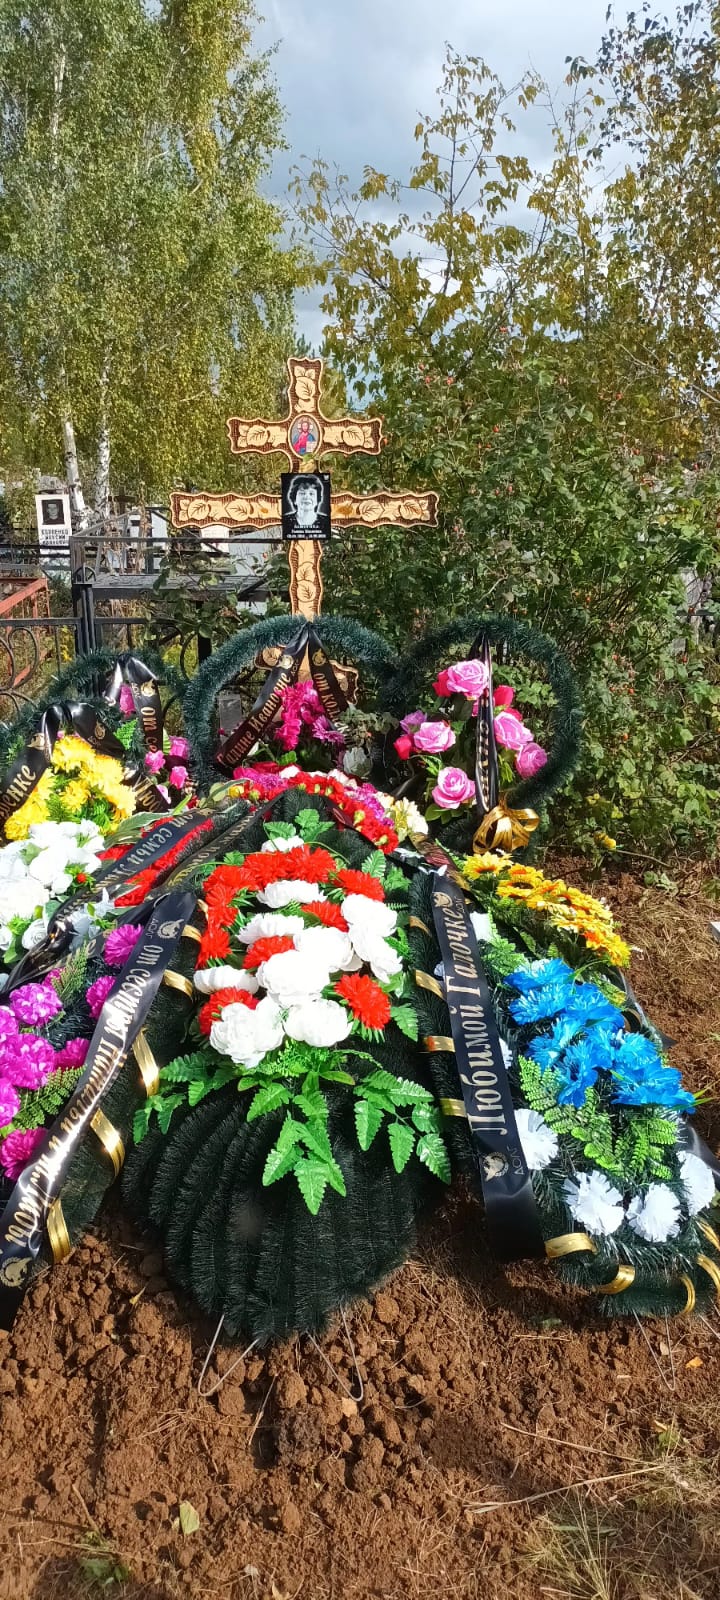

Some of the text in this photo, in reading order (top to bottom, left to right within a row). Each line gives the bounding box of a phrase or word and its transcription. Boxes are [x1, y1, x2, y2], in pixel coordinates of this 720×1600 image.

[313, 672, 330, 691] от
[140, 706, 156, 730] от
[216, 730, 255, 768] Галине
[247, 672, 291, 732] Ивановне
[127, 826, 172, 866] семьи
[135, 946, 163, 965] от
[102, 970, 150, 1040] сестры
[444, 909, 507, 1134] Любимой Галочке
[506, 1144, 525, 1175] ДОЛГ
